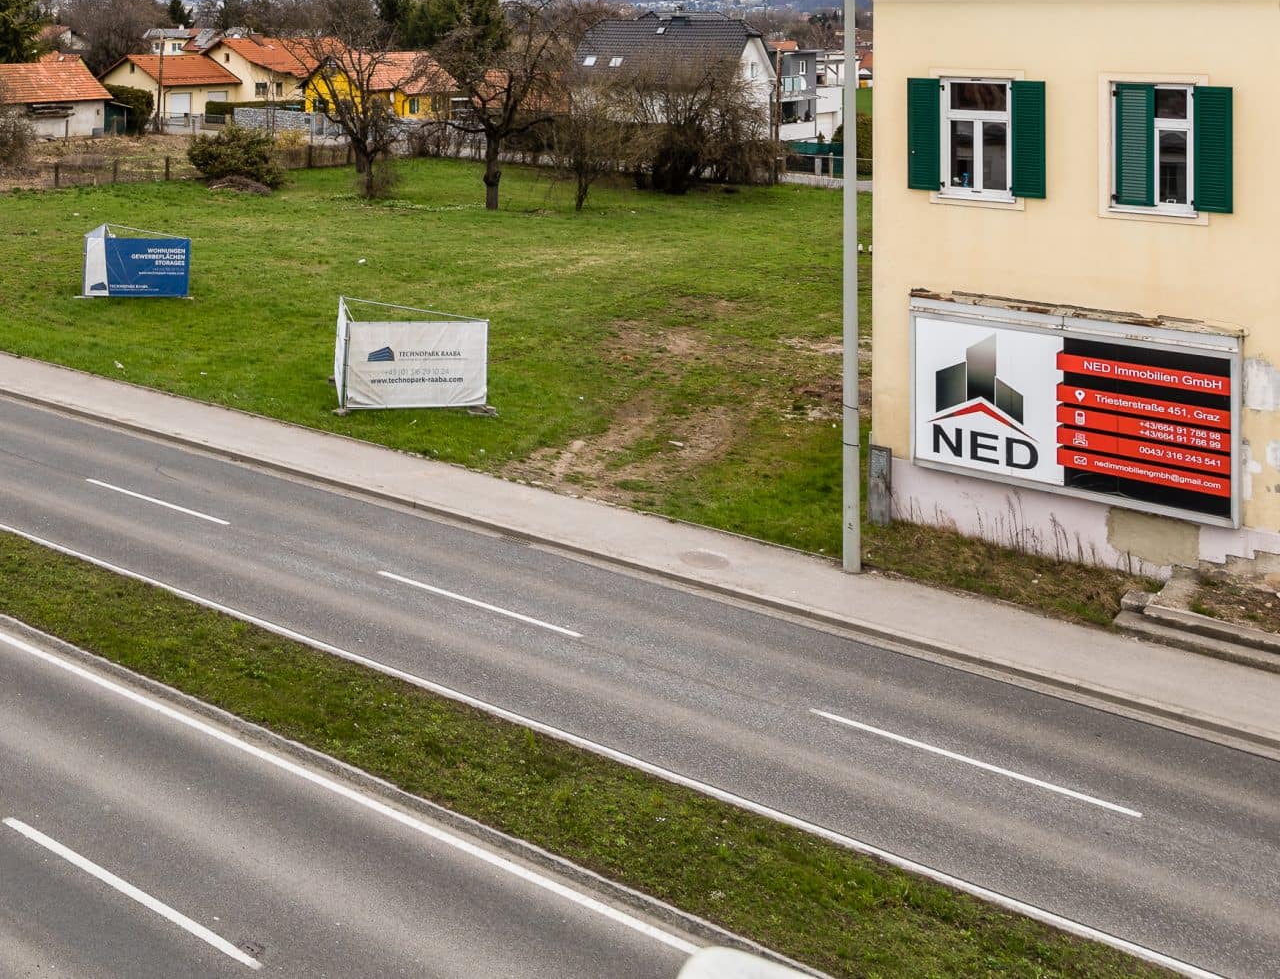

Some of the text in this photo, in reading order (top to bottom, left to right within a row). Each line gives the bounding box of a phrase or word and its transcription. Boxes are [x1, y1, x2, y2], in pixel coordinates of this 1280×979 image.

[370, 375, 464, 385] www.technopark-raaba.com
[1083, 360, 1222, 390] NED Immobilien GmbH
[1094, 394, 1165, 413] Triesterstraße
[1193, 410, 1221, 422] Graz
[1176, 426, 1187, 435] 91
[1209, 432, 1221, 440] 98
[1176, 435, 1187, 443] 91
[1209, 441, 1221, 449] 99
[931, 424, 1039, 470] NED
[1139, 446, 1221, 467] 0043/ 316 243 541
[1094, 459, 1222, 490] nedimmobiliengmbh@gmail.com
